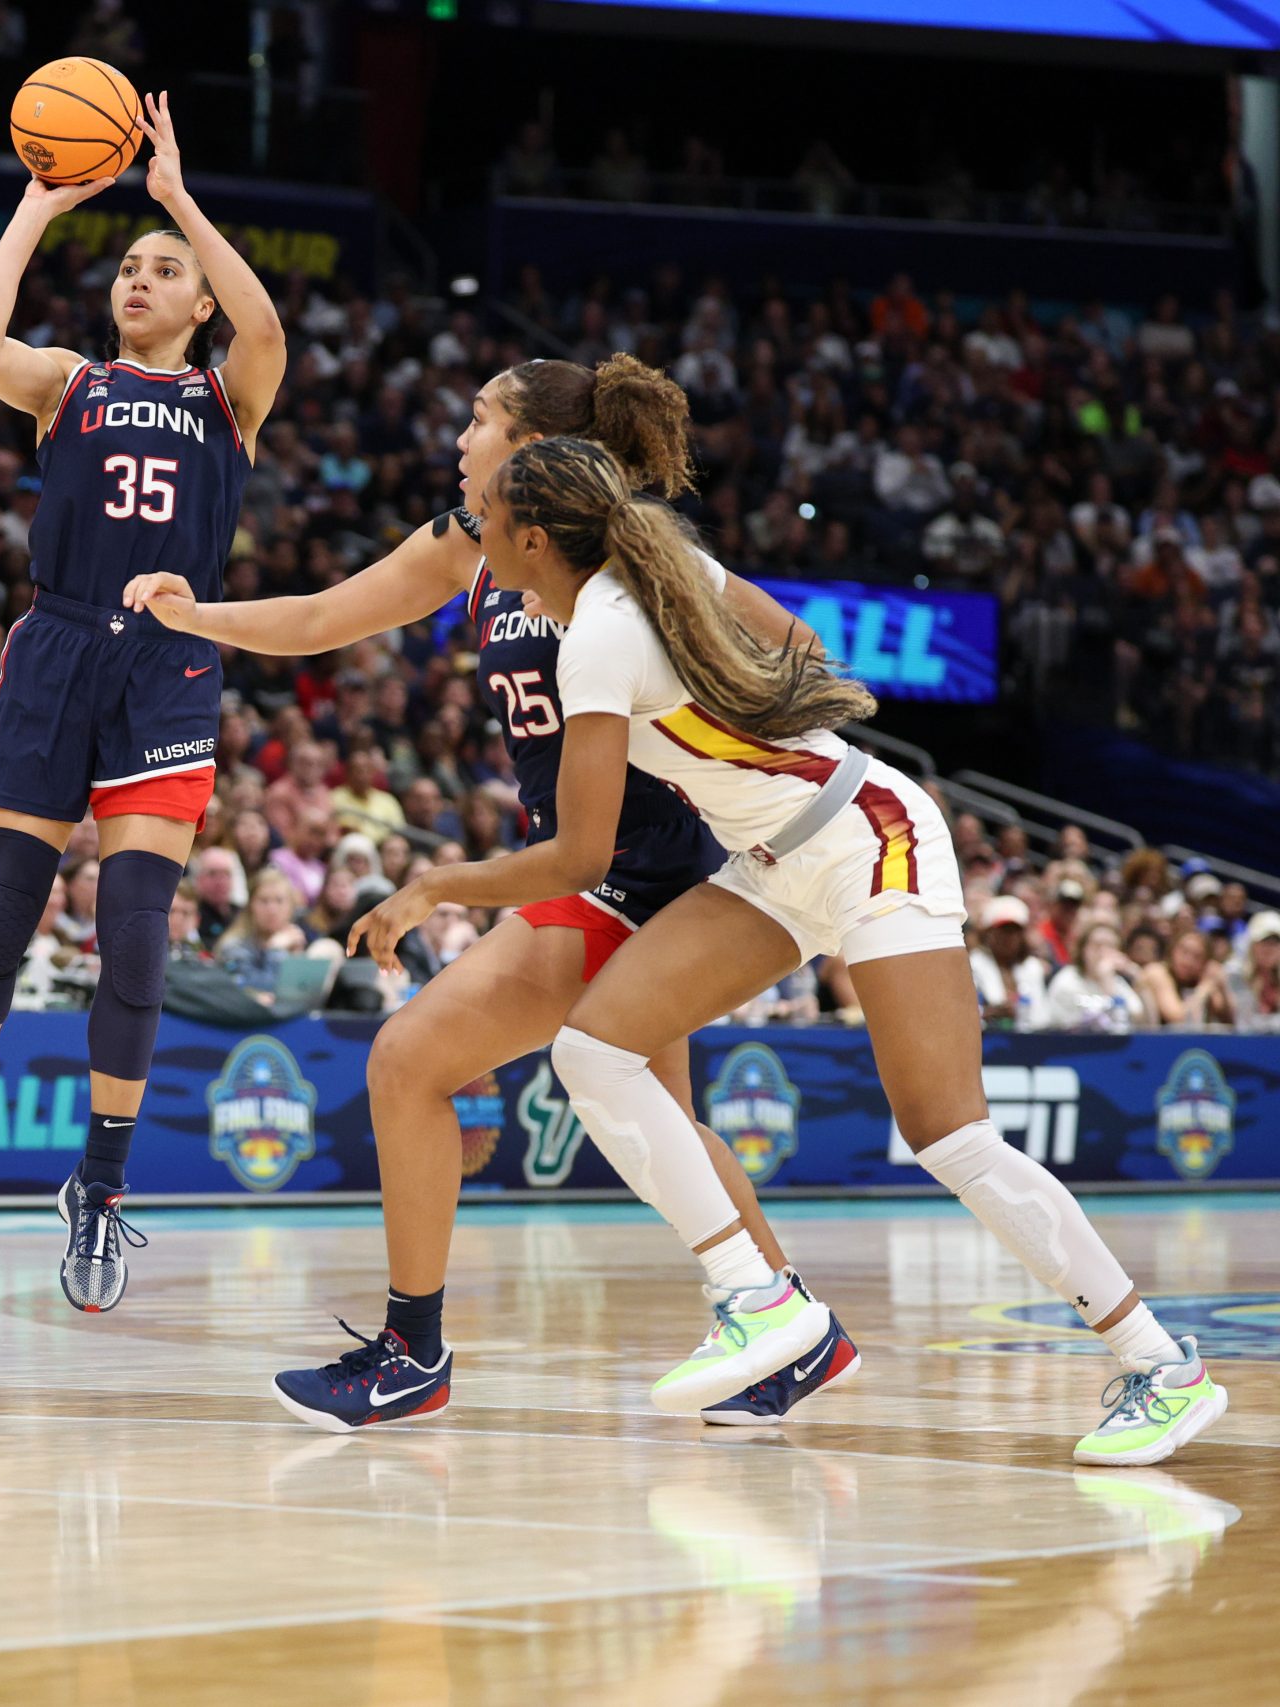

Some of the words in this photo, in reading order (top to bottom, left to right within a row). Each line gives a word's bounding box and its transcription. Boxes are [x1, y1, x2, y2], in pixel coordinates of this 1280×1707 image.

[80, 401, 204, 444] UCONN
[104, 453, 179, 524] 35
[488, 670, 561, 738] 25
[144, 738, 214, 764] HUSKIES
